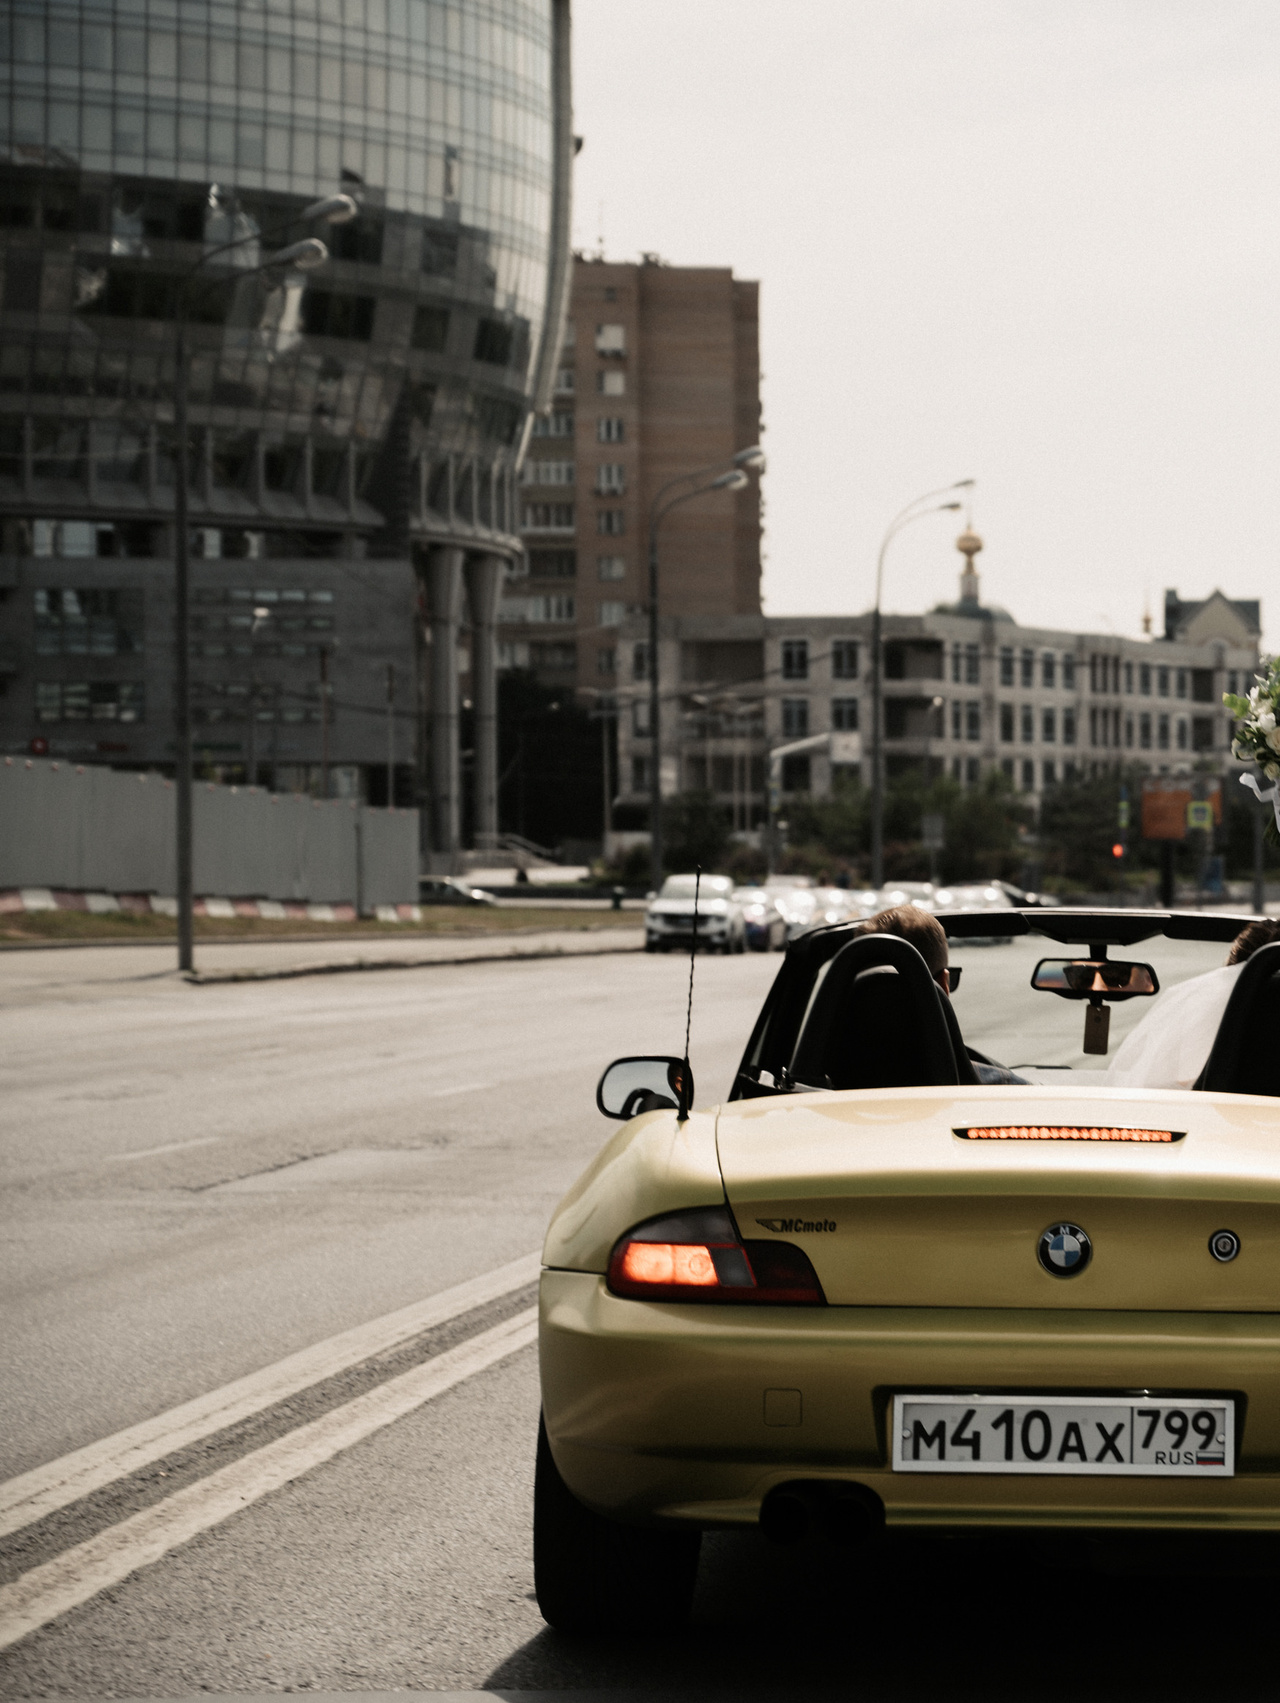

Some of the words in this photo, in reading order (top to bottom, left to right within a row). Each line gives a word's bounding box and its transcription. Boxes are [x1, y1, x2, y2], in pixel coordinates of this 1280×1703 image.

[780, 1218, 837, 1233] MCmoto
[1043, 1225, 1087, 1243] BMW
[1136, 1409, 1217, 1450] 799
[1154, 1451, 1194, 1465] RUS
